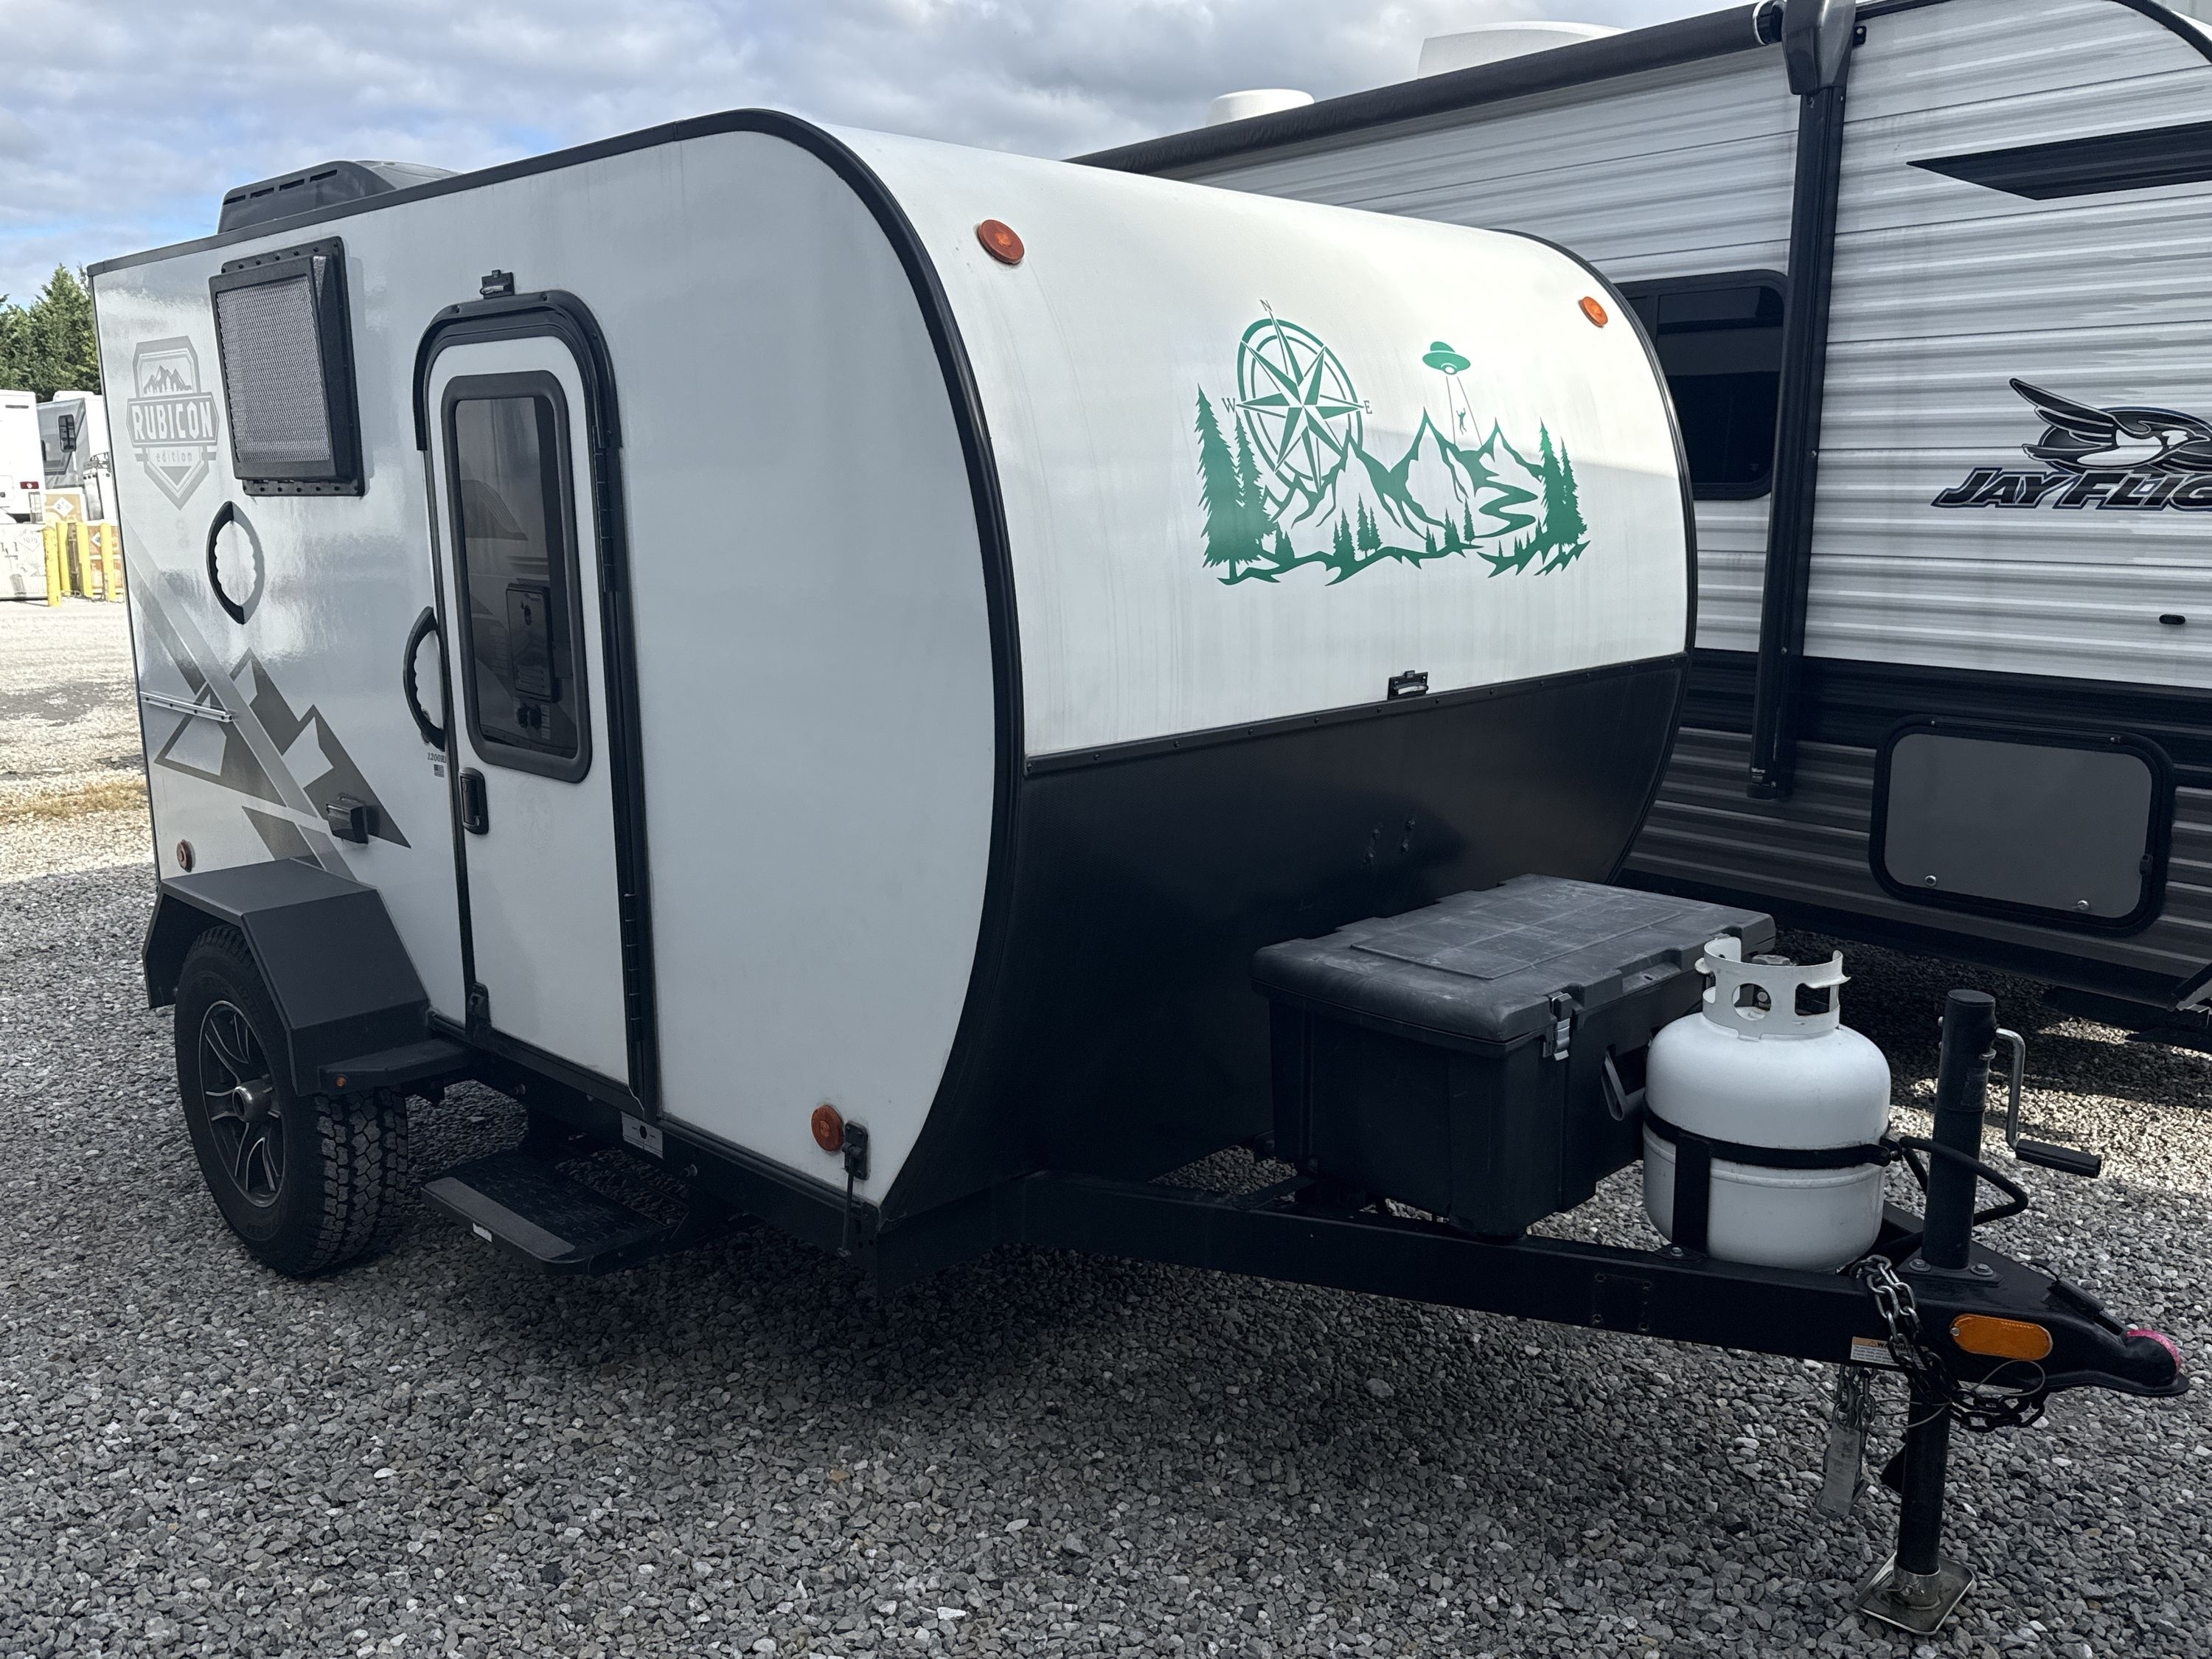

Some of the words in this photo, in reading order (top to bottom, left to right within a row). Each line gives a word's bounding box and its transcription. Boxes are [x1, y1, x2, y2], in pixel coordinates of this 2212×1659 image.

[1259, 299, 1273, 312] N
[1221, 397, 1236, 413] W
[1363, 400, 1373, 414] E
[131, 401, 214, 440] RUBICON
[156, 449, 192, 462] edition
[1931, 467, 2076, 509] JAY
